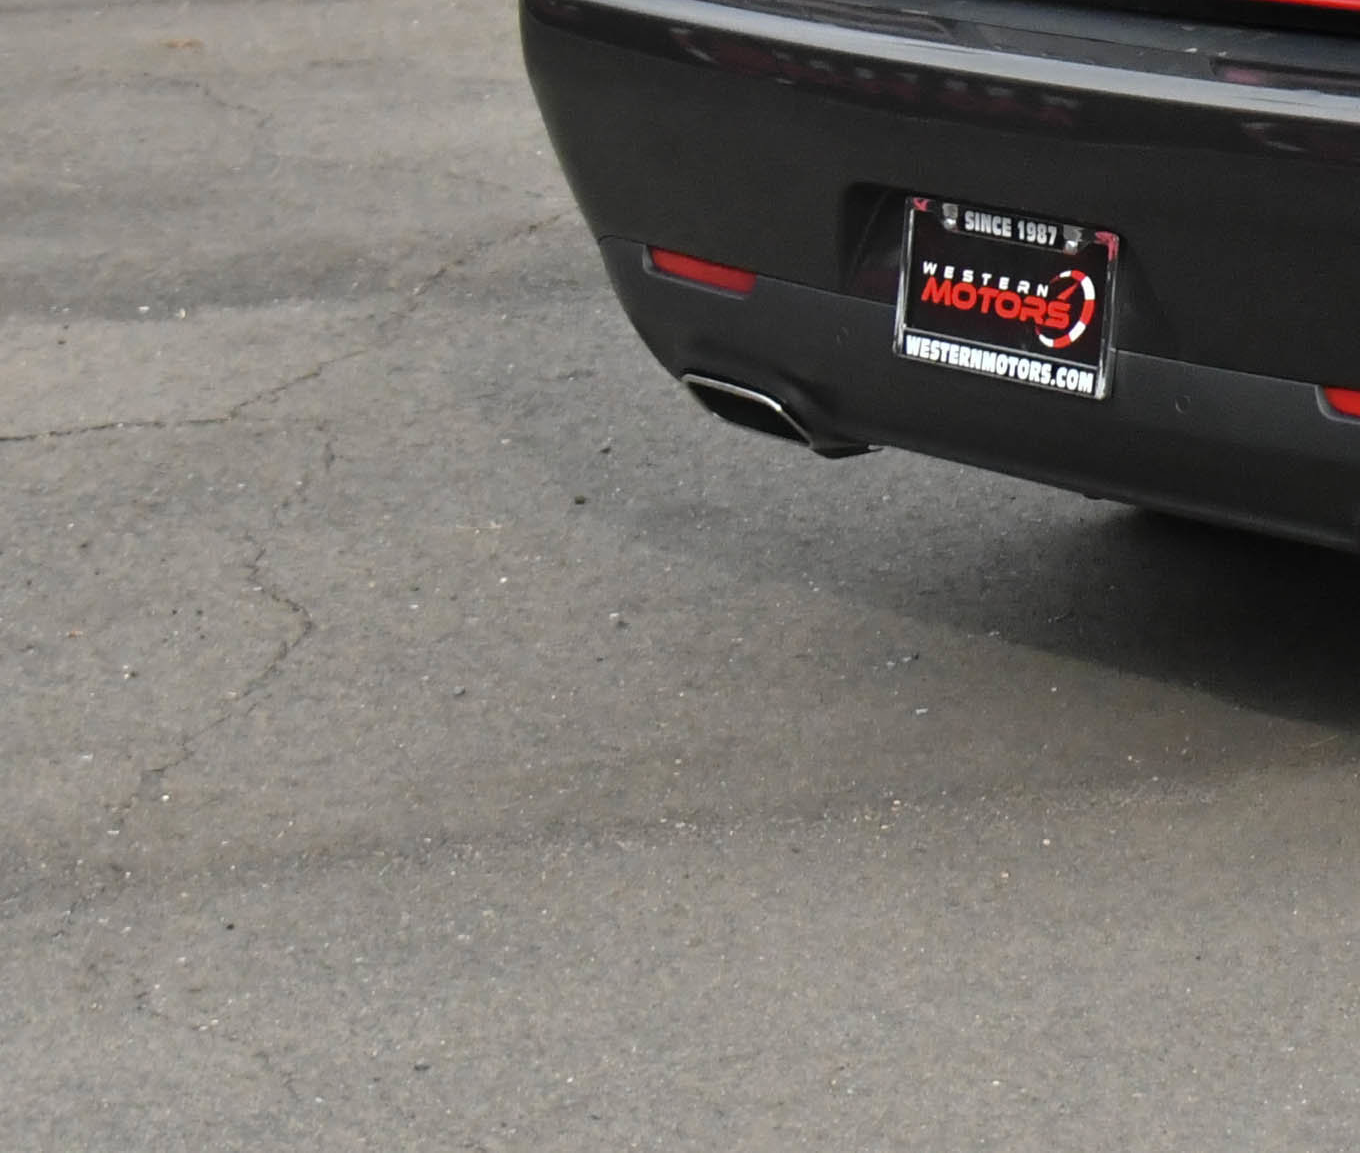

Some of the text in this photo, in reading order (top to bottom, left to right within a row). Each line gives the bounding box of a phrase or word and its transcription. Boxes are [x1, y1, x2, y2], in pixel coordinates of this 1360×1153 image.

[964, 210, 1058, 246] SINCE 1987
[922, 260, 1049, 298] WESTERN
[920, 276, 1071, 330] MOTORS
[906, 334, 1095, 394] WESTERNMOTORS.COM
